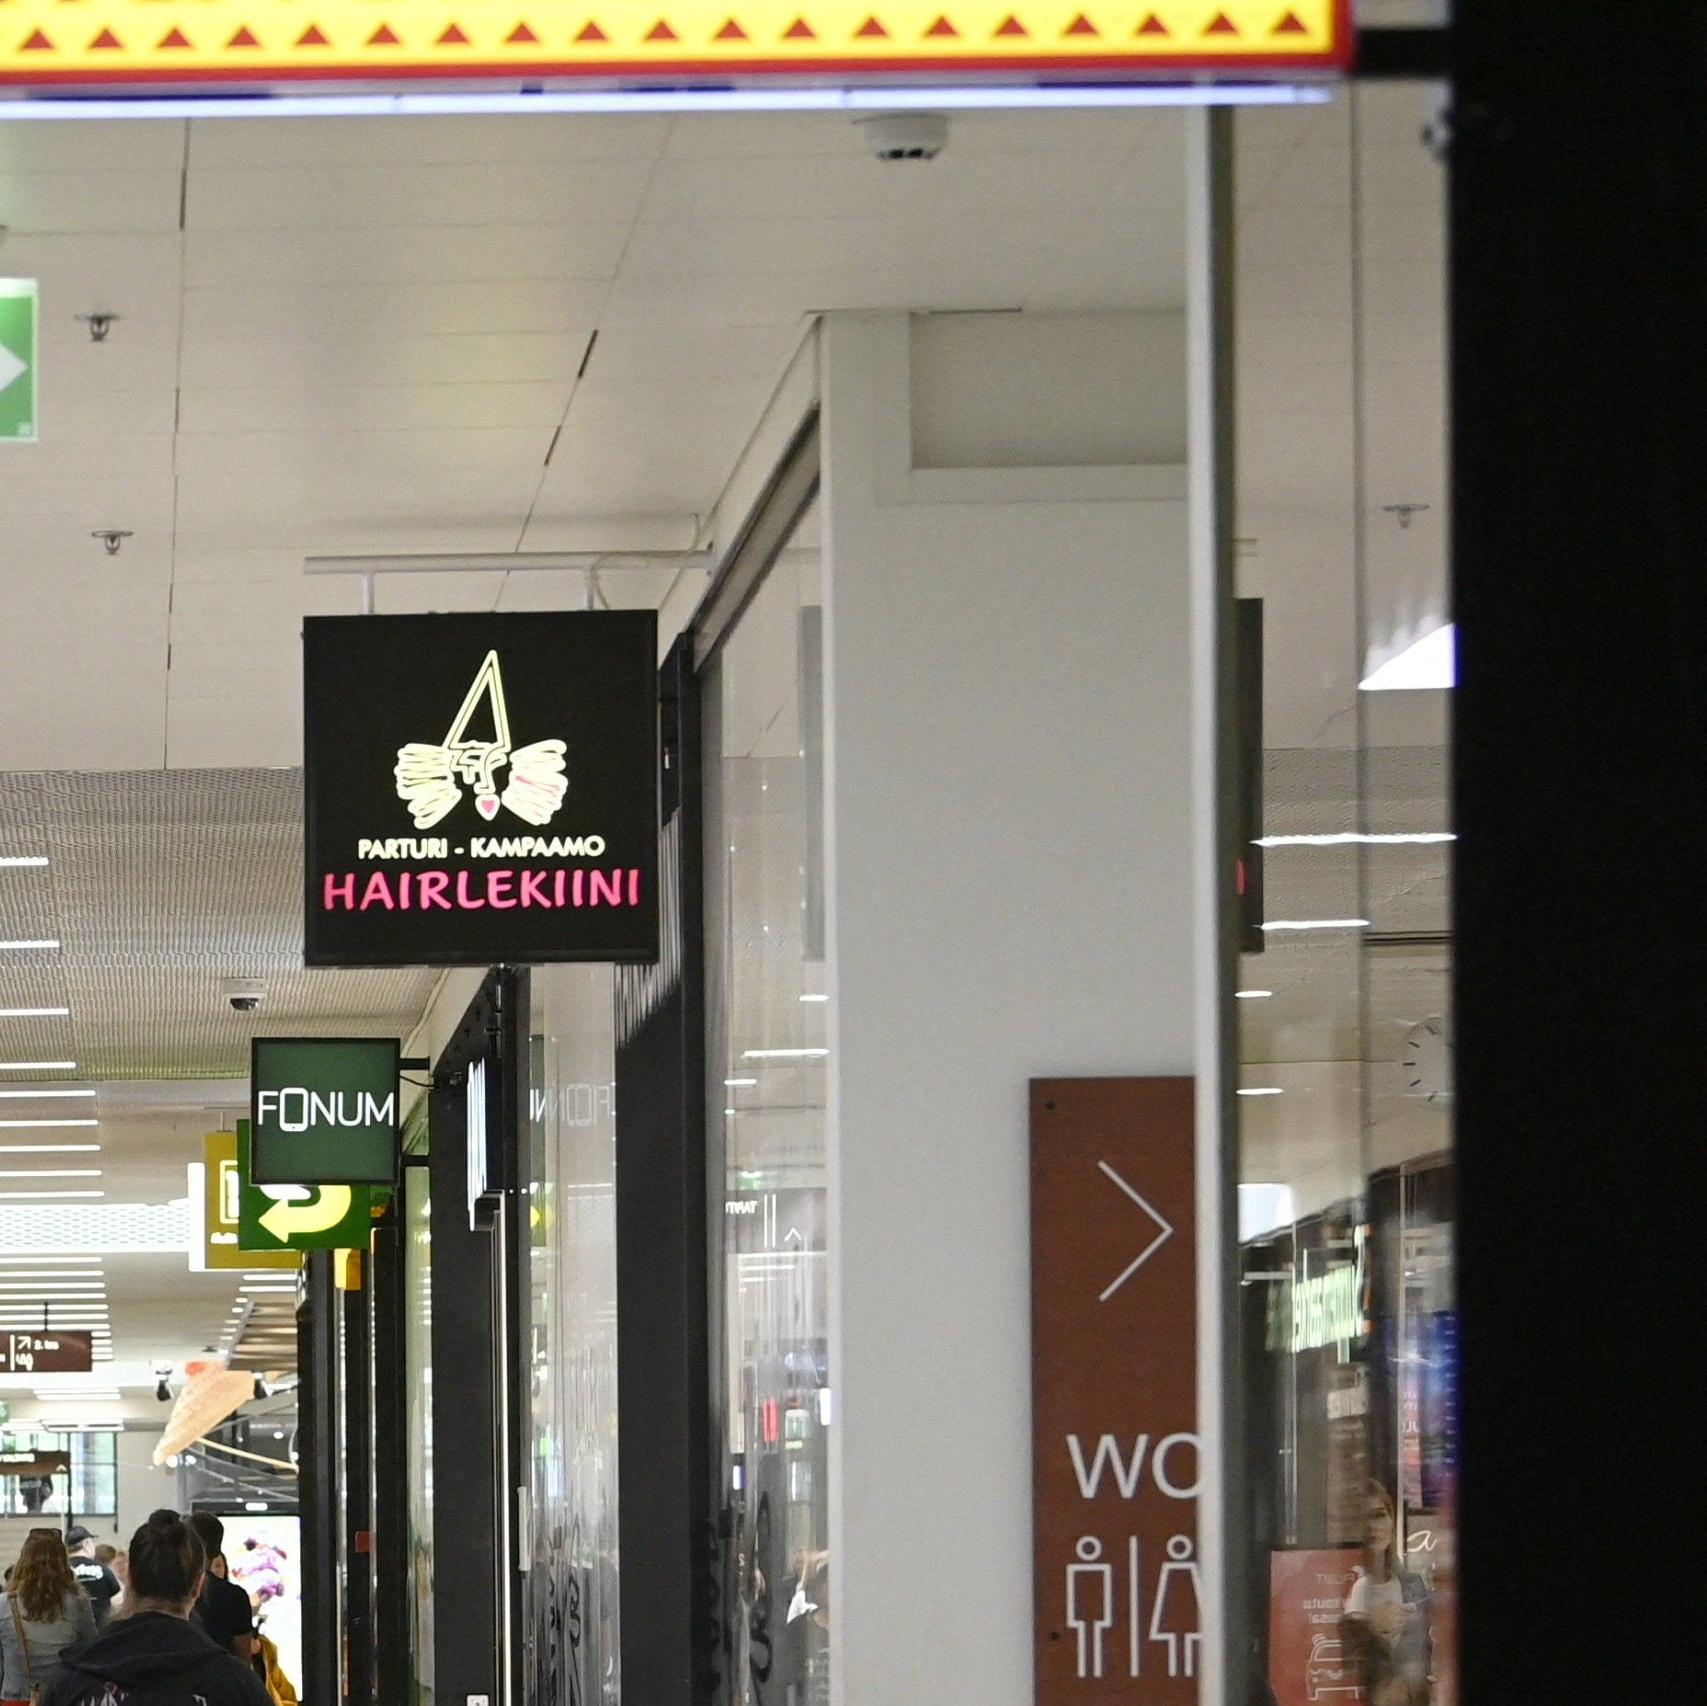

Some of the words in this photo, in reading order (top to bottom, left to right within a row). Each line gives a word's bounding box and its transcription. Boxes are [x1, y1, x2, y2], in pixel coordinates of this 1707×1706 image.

[357, 837, 449, 860] PARTURI
[470, 834, 606, 858] KAMPAAMO
[323, 868, 640, 911] HAIRLEKIINI
[257, 1086, 395, 1132] FONUM
